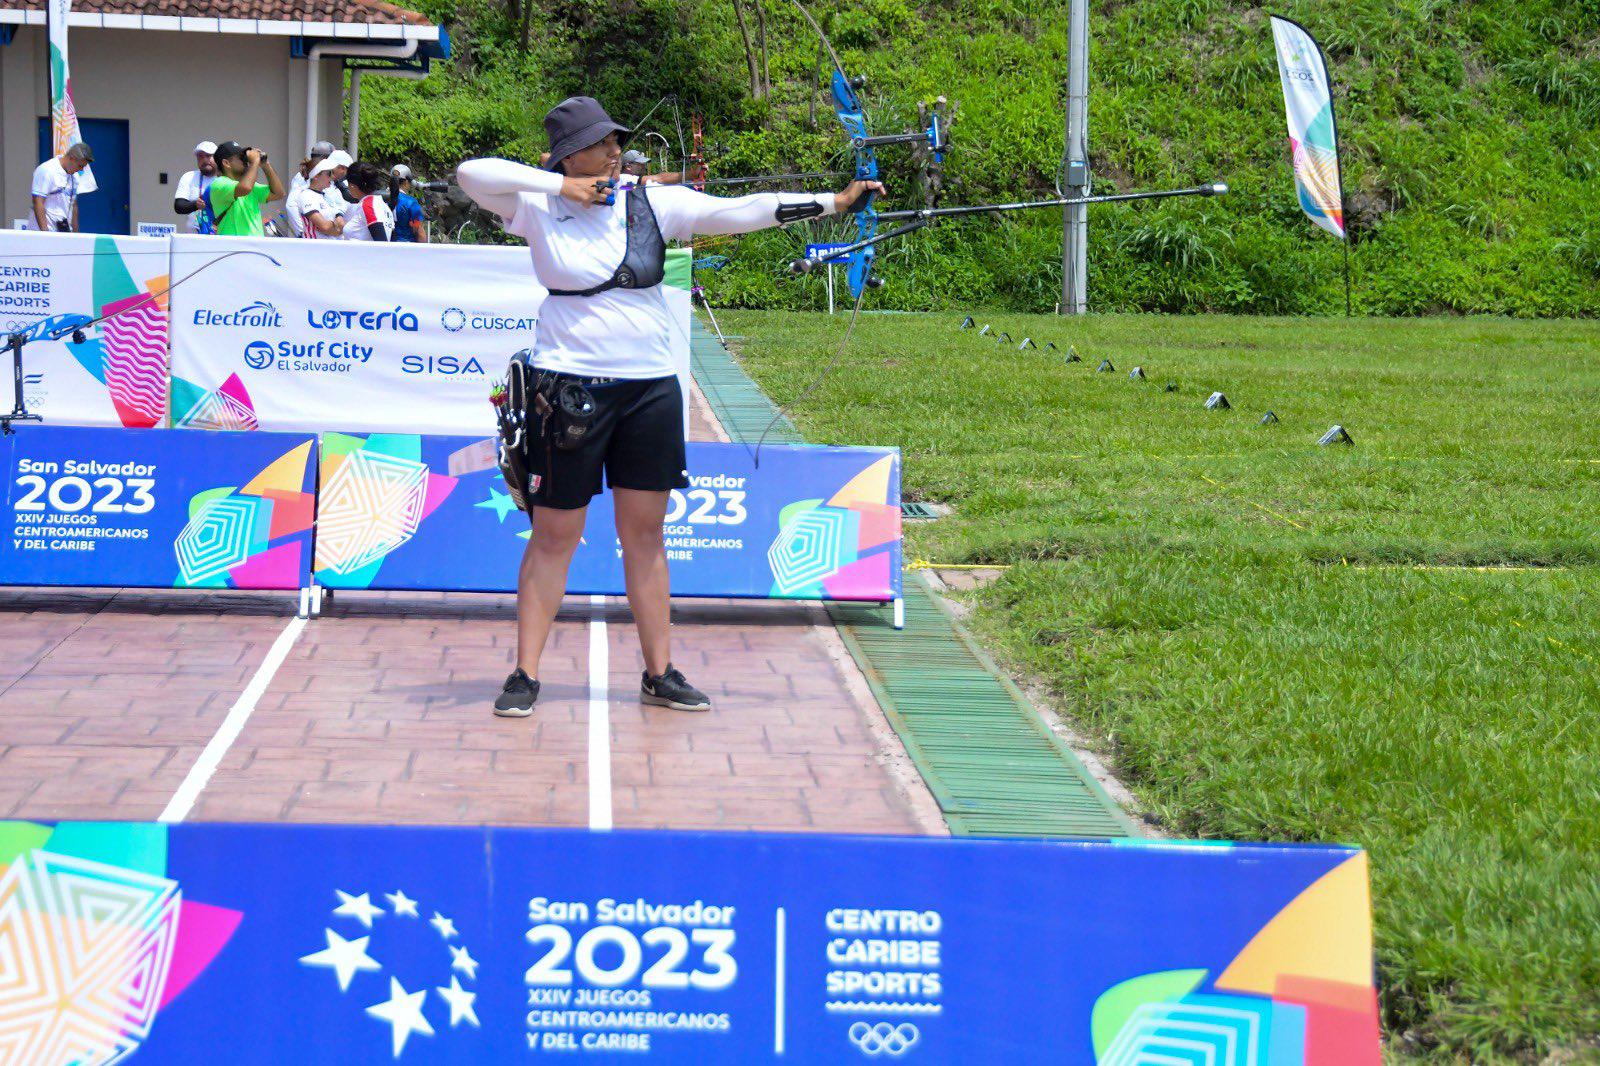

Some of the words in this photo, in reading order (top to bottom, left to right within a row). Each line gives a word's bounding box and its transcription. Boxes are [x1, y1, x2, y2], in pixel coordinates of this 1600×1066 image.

[0, 266, 50, 278] ENTRO
[193, 307, 283, 328] Electrolit
[278, 341, 325, 358] Surf
[328, 341, 374, 363] City
[278, 360, 290, 371] El
[294, 360, 352, 372] Salvador
[401, 355, 485, 375] SISA
[18, 458, 59, 474] San
[63, 459, 157, 476] Salvador
[688, 473, 746, 488] vador
[13, 474, 156, 514] 2023
[15, 513, 44, 523] XXIV
[46, 514, 98, 525] JUEGOS
[14, 525, 149, 539] CENTROAMERICANOS
[662, 525, 693, 535] EGOS
[13, 539, 23, 549] Y
[24, 539, 49, 550] DEL
[50, 539, 96, 551] CARIBE
[666, 550, 693, 560] RIBE
[528, 897, 590, 922] San
[596, 897, 736, 925] Salvador
[825, 908, 942, 932] CENTRO
[524, 922, 739, 989] 2023
[826, 938, 941, 965] CARIBE
[826, 969, 942, 996] SPORTS
[527, 988, 572, 1006] XXIV
[574, 988, 652, 1007] JUEGOS
[525, 1009, 731, 1030] CENTROAMERICANOS
[526, 1031, 539, 1049] Y
[542, 1032, 579, 1050] DEL
[581, 1032, 651, 1051] CARIBE
